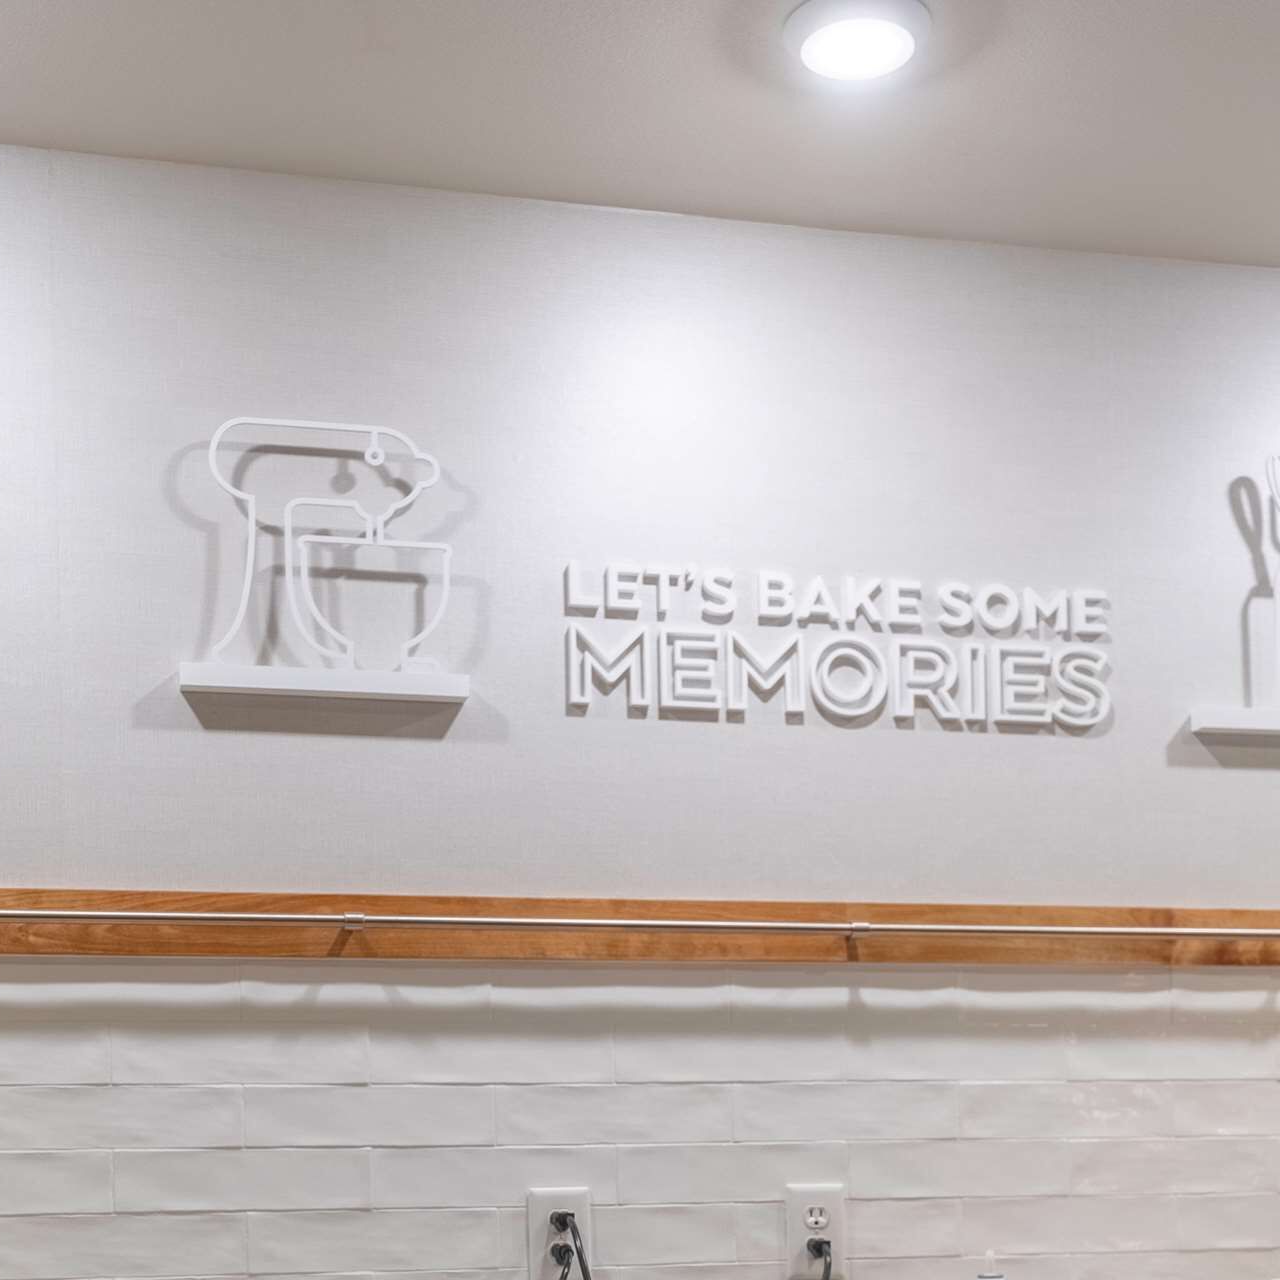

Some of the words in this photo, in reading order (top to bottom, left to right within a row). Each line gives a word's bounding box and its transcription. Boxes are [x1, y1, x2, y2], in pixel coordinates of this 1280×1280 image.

[564, 560, 734, 624] LET'S
[758, 570, 924, 632] BAKE
[937, 580, 1111, 641] SOME
[564, 622, 1114, 737] MEMORIES
